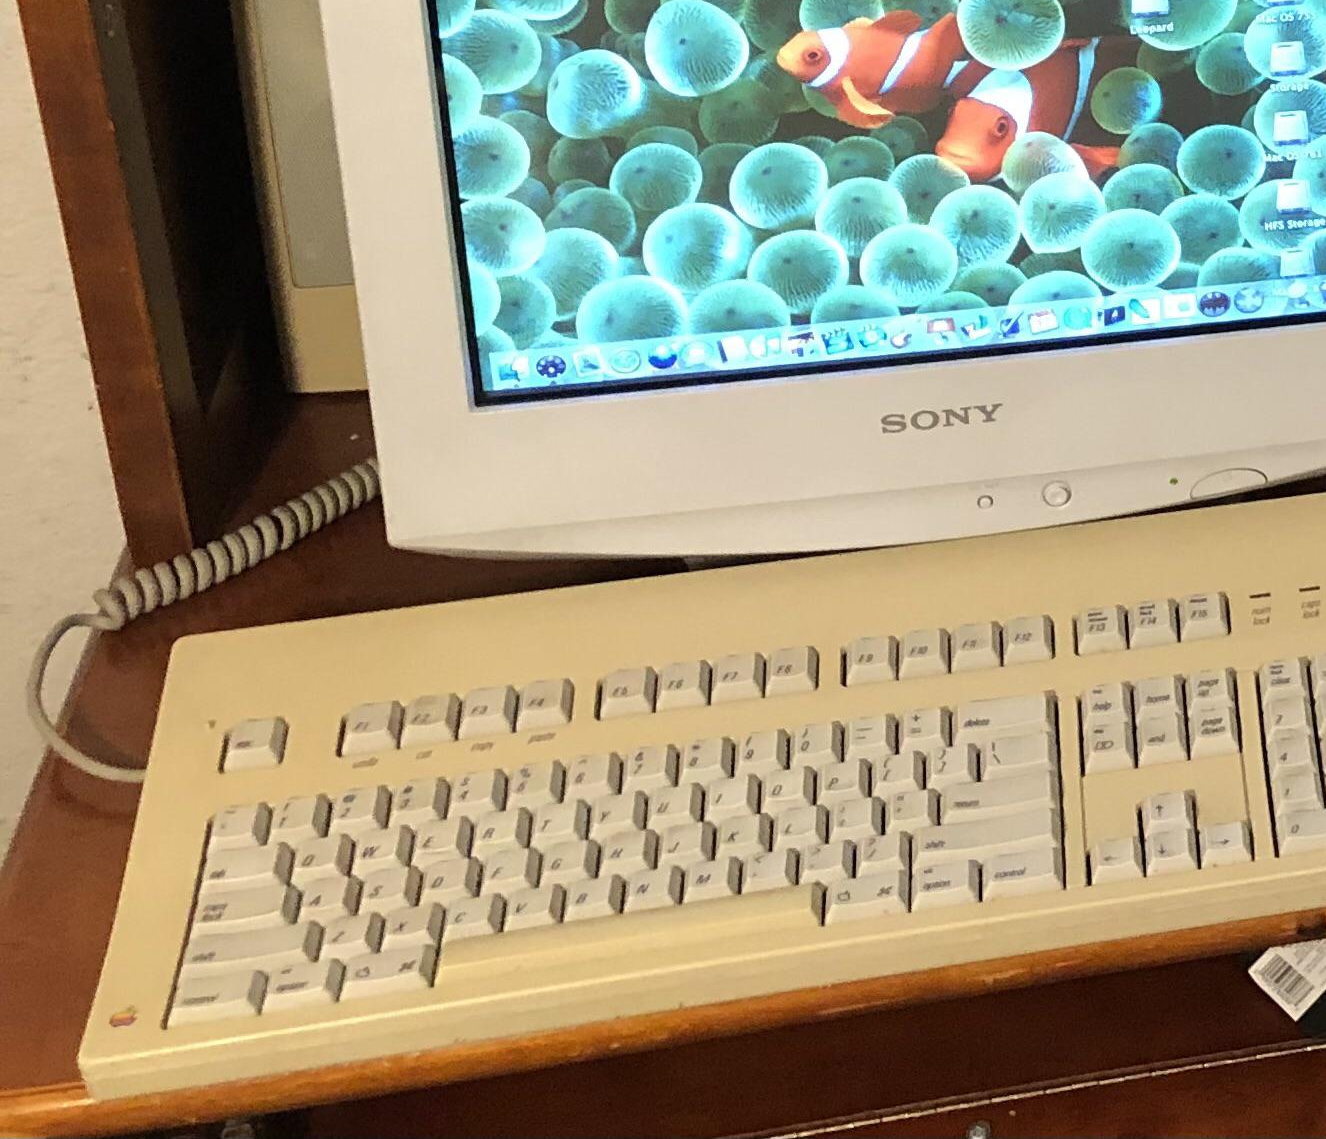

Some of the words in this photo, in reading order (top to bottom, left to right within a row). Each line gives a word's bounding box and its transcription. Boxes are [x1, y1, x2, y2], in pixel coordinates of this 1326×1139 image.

[1129, 22, 1175, 35] Leopard
[1287, 218, 1326, 230] Storage
[880, 402, 1003, 434] SONY
